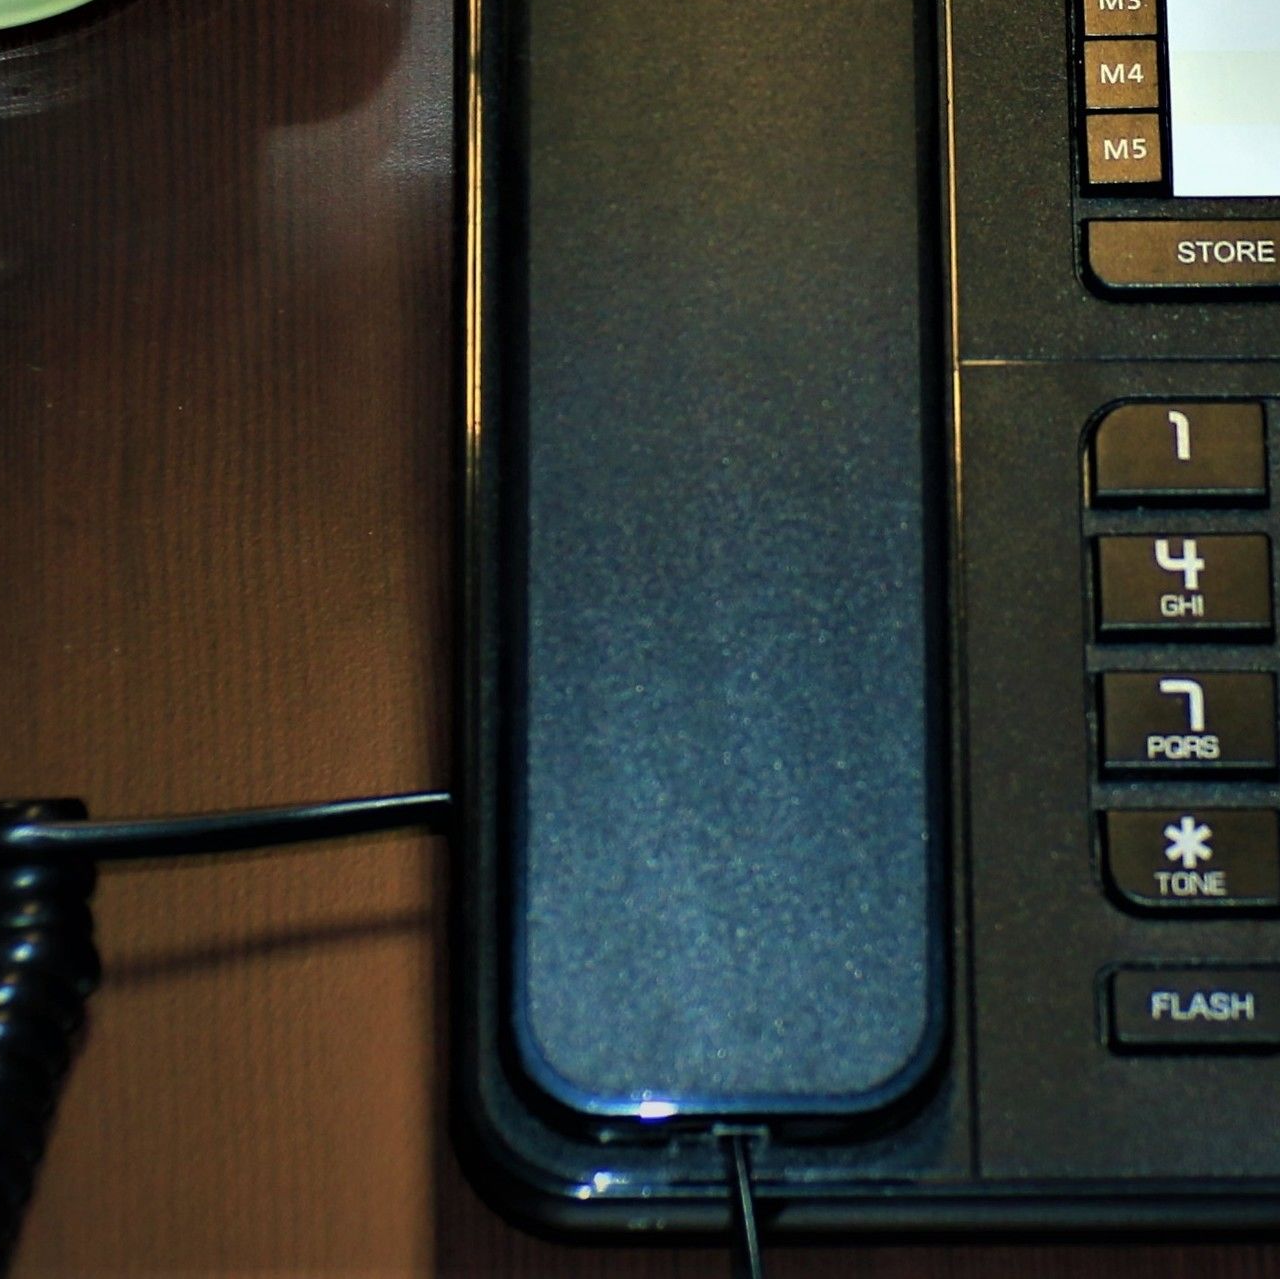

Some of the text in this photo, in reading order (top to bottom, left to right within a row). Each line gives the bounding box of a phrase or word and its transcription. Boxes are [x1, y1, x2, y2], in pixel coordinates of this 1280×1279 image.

[1100, 63, 1144, 84] M4
[1103, 138, 1147, 160] M5
[1177, 240, 1276, 264] STORE
[1168, 410, 1191, 460] 1
[1155, 539, 1205, 590] 4
[1160, 594, 1204, 617] GHI
[1159, 679, 1205, 732] 7
[1147, 735, 1219, 759] PQRS
[1158, 872, 1224, 895] TONE
[1151, 992, 1254, 1020] FLASH
